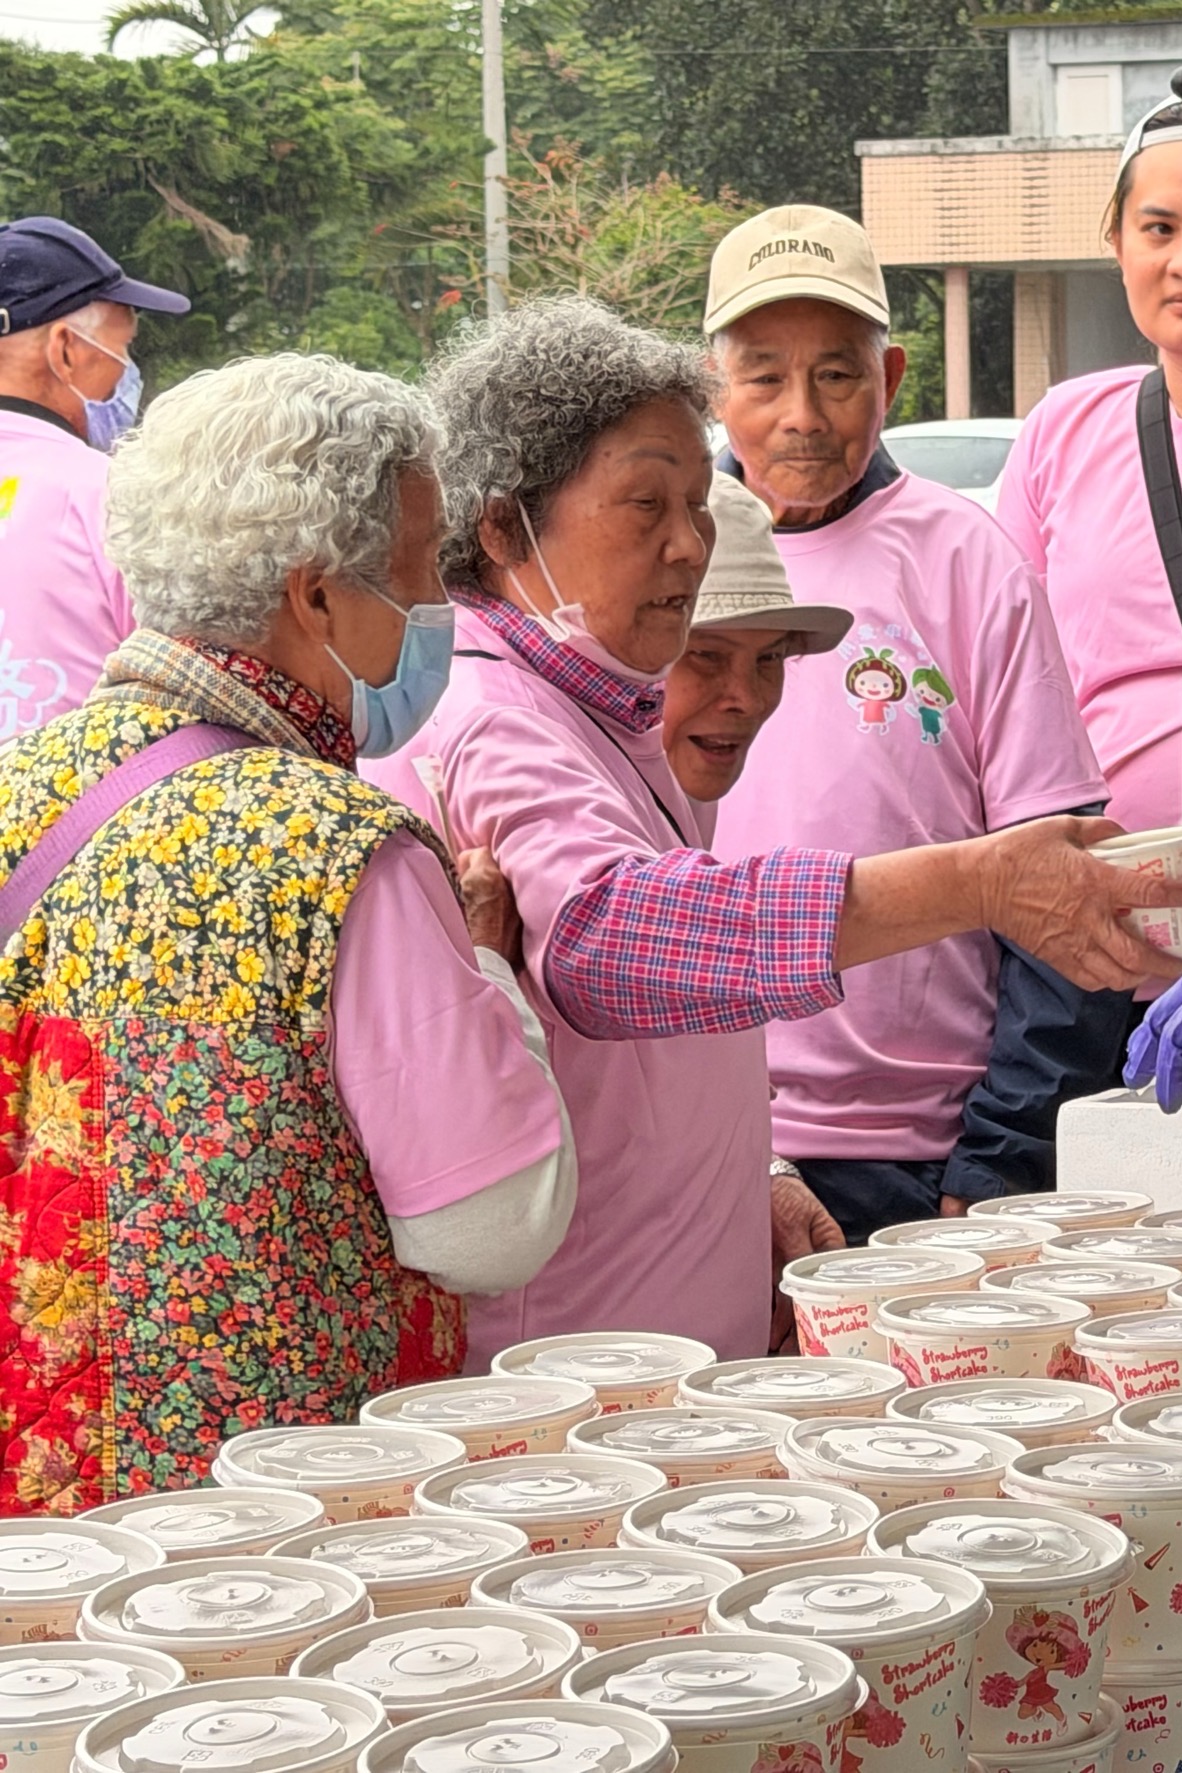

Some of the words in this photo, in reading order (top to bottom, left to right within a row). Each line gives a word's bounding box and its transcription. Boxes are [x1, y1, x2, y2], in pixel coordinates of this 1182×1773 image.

[747, 239, 835, 271] COLORADO
[811, 1302, 868, 1321] Strawberry
[819, 1315, 869, 1337] Shortcake
[922, 1344, 988, 1365] Strawberry
[930, 1361, 988, 1383] Shortcake
[1115, 1357, 1179, 1381] Strawberry
[1123, 1378, 1180, 1400] Shortcake
[881, 1641, 956, 1685] Strawberry
[893, 1659, 955, 1704] Shortcake
